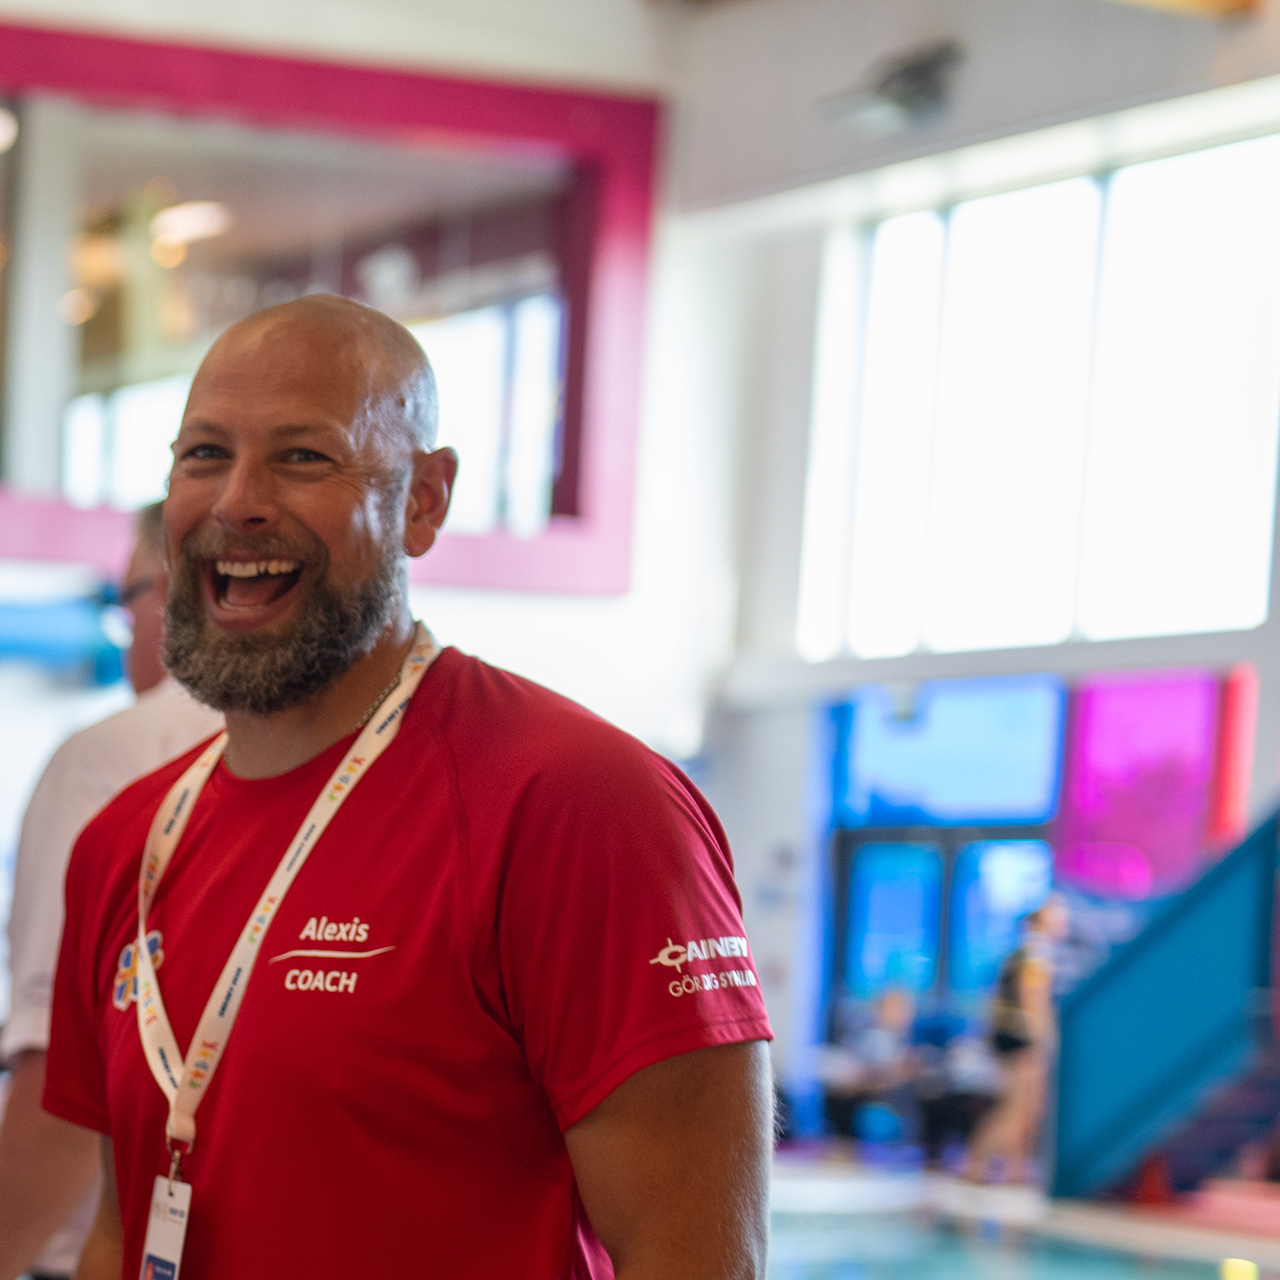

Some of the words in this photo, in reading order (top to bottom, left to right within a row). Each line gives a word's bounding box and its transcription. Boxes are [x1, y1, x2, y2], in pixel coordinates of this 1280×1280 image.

[299, 915, 370, 943] Alexis
[284, 968, 358, 994] COACH
[668, 974, 703, 998] GÖR
